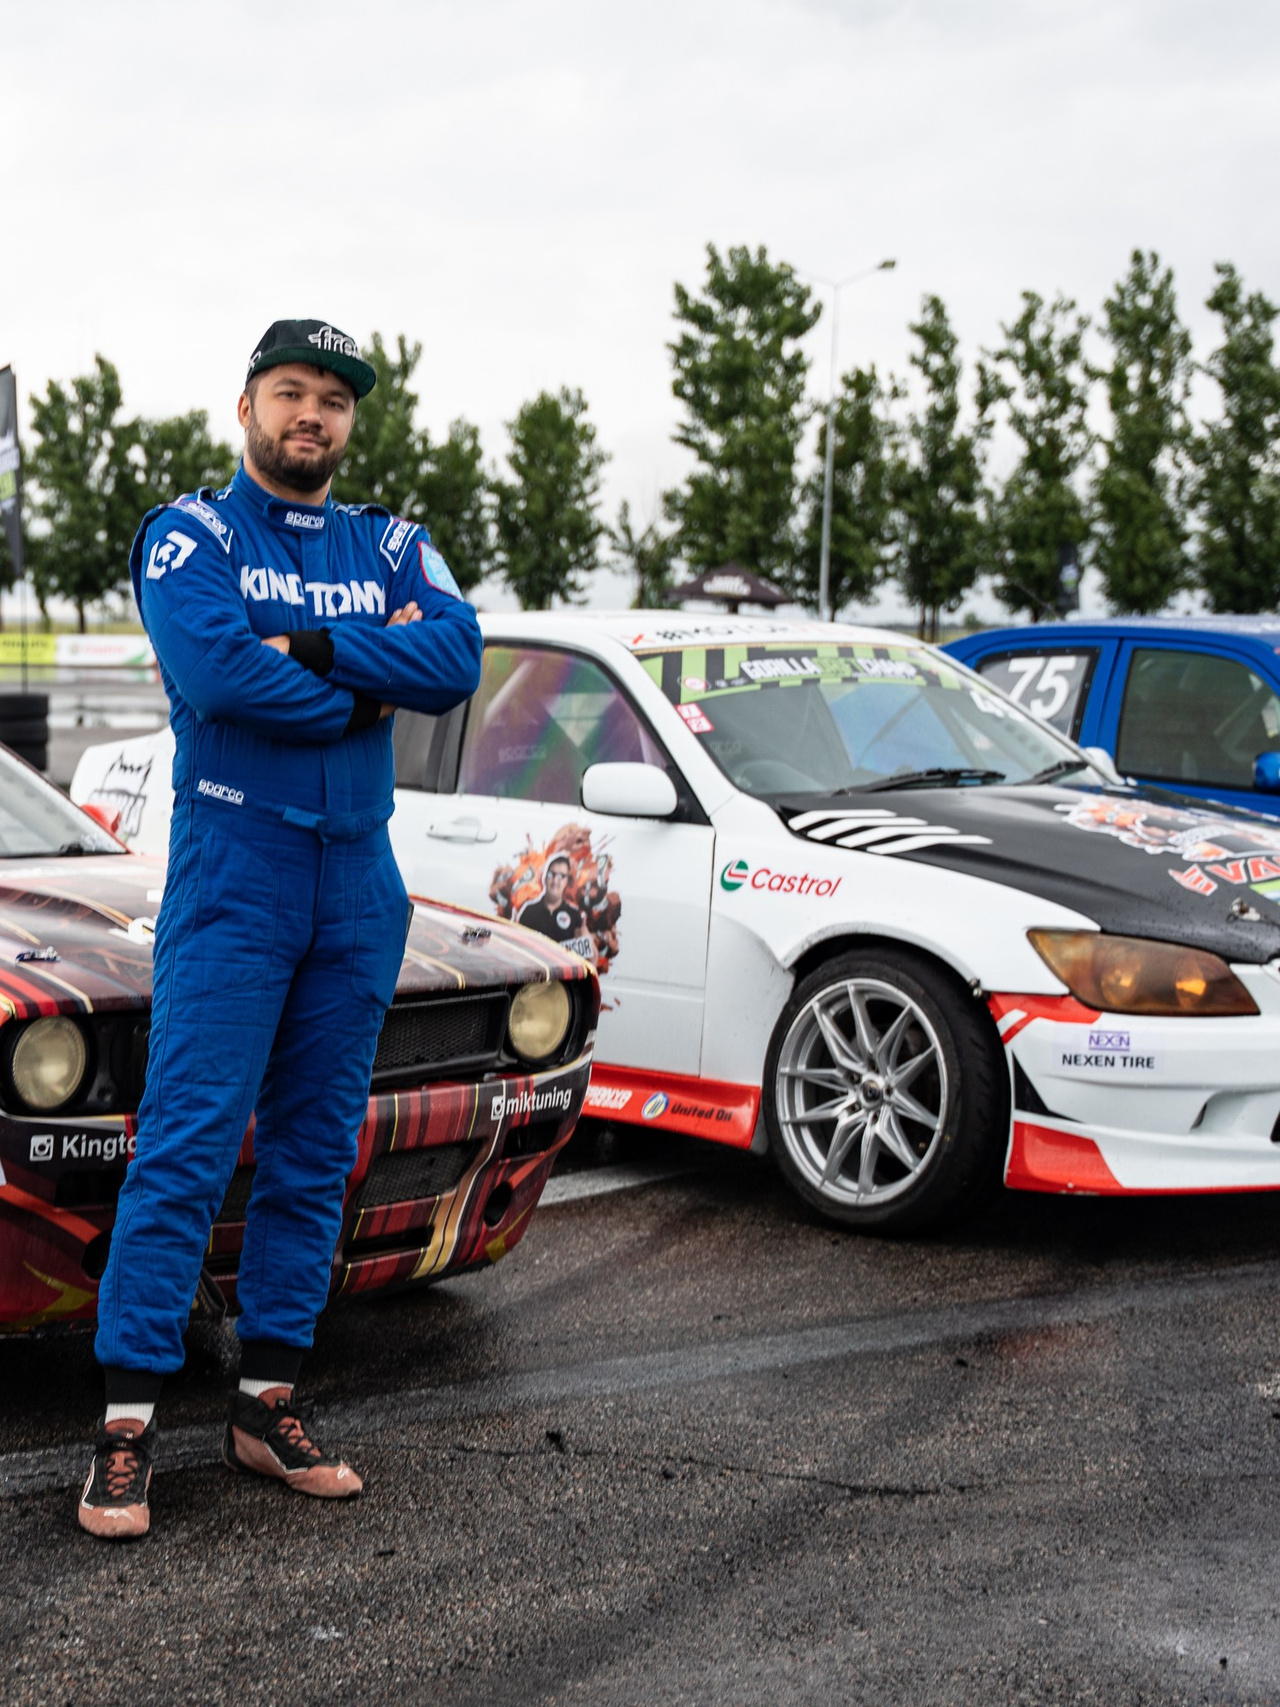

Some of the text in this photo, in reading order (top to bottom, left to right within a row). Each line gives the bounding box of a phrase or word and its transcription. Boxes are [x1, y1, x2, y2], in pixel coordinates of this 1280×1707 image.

[284, 510, 325, 530] sparco
[305, 580, 386, 617] TONY
[1007, 656, 1077, 721] 75
[196, 778, 244, 806] sparco
[751, 868, 843, 898] Castrol
[1088, 1032, 1130, 1048] NEXEN
[1061, 1053, 1155, 1069] NEXEN TIRE
[505, 1086, 573, 1116] miktuning
[670, 1102, 733, 1123] United Oil
